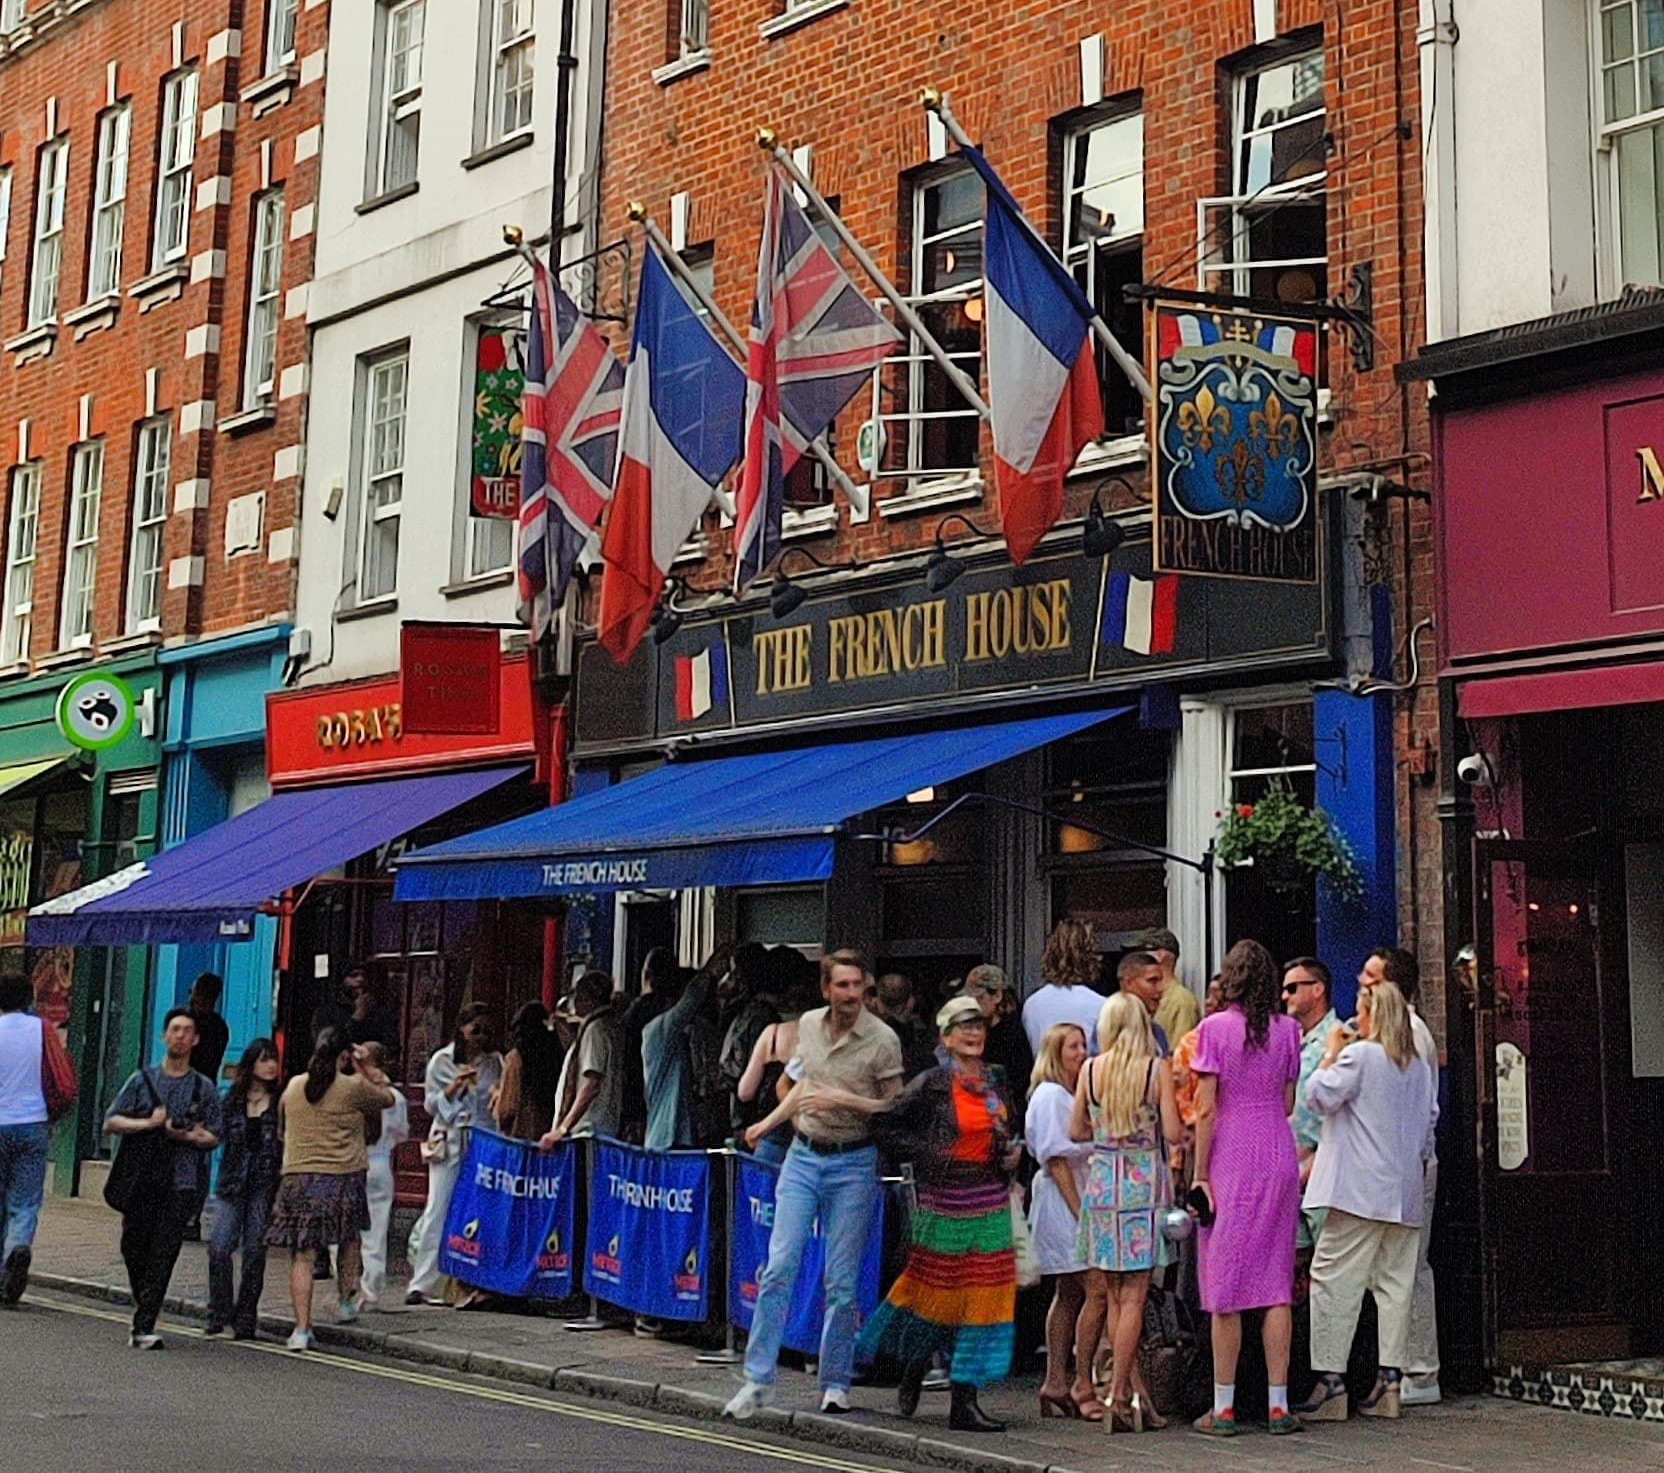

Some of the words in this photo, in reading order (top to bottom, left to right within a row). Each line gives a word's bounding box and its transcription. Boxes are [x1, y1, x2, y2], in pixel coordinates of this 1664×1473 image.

[480, 477, 516, 507] THE
[1160, 515, 1244, 573] FRENCH
[753, 624, 812, 695] THE
[827, 599, 946, 683] FRENCH
[964, 579, 1071, 661] HOUSE
[542, 864, 563, 885] THE
[564, 861, 607, 884] FRENCH
[607, 858, 648, 883] HOUSE
